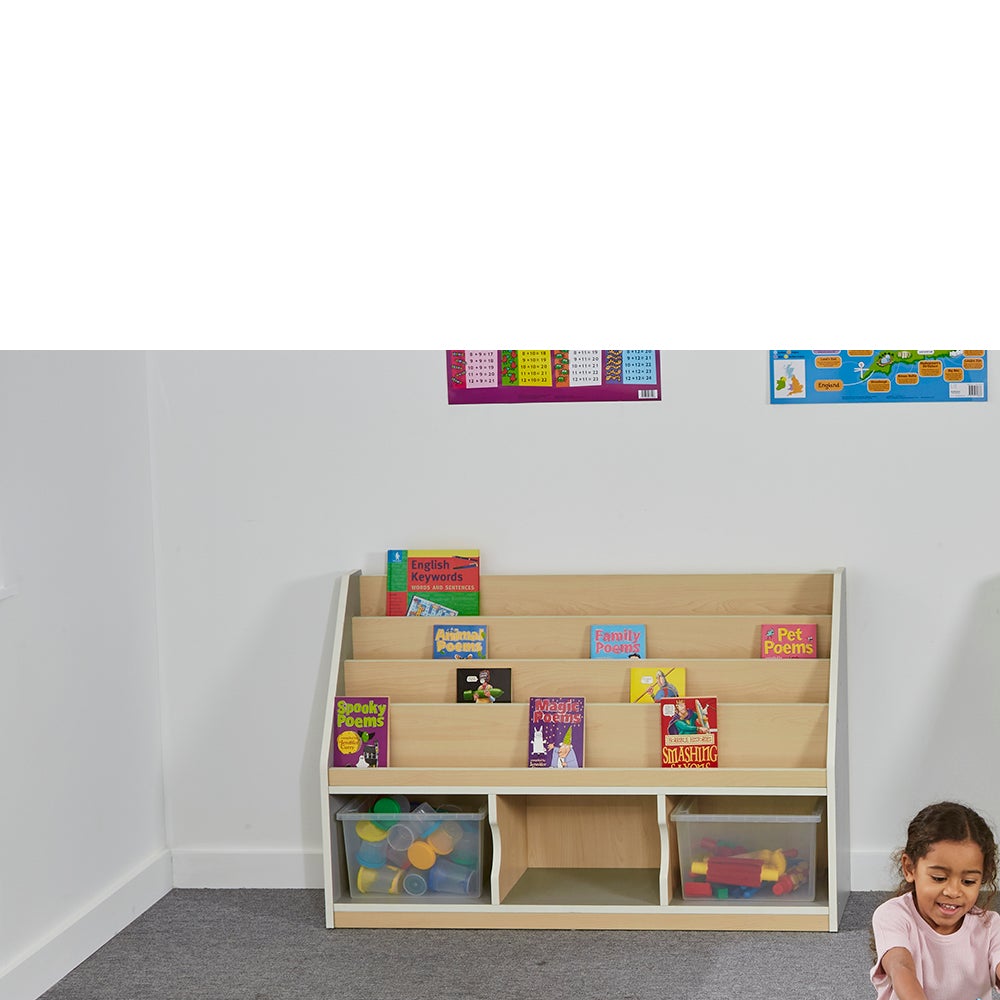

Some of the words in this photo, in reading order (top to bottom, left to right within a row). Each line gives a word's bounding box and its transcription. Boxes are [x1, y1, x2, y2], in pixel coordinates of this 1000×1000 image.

[411, 560, 450, 572] English
[411, 572, 463, 584] Keywords
[435, 628, 484, 641] Animal
[595, 629, 641, 643] Family
[778, 627, 803, 642] Pet
[436, 641, 483, 653] Poems
[595, 641, 640, 654] Poems
[764, 640, 814, 655] Poems
[337, 700, 387, 717] Spooky
[535, 699, 580, 715] Magic
[337, 714, 384, 728] Poems
[533, 710, 581, 724] Poems
[662, 745, 718, 764] SMASHING
